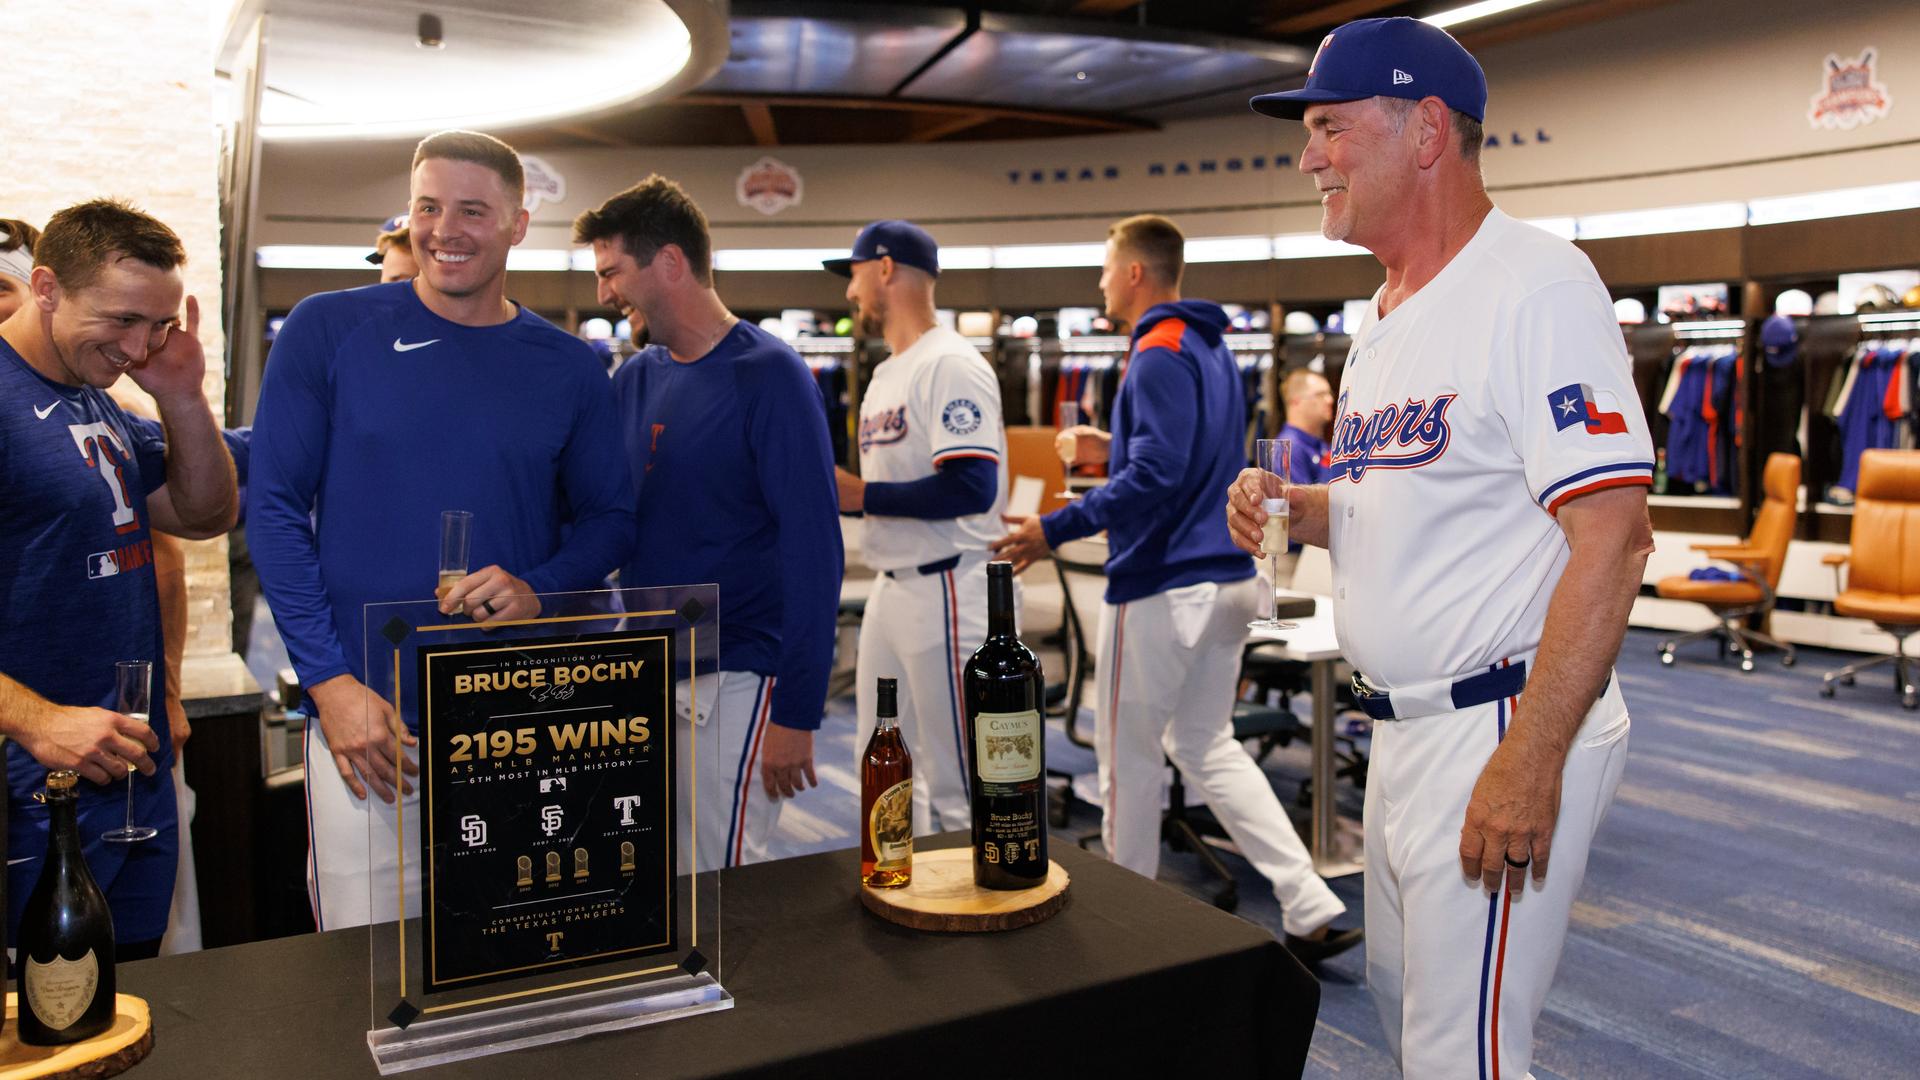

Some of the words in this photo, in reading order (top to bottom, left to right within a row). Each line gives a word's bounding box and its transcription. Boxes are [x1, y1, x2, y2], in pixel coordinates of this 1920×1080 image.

[1008, 166, 1120, 184] TEXAS
[1148, 154, 1293, 176] RANGER
[68, 421, 140, 536] T
[500, 660, 511, 668] IN
[516, 655, 585, 666] RECOGNITION
[590, 654, 602, 662] OF
[455, 668, 547, 694] BRUCE
[554, 660, 645, 686] BOCHY
[450, 727, 538, 763] 2195
[548, 716, 651, 752] WINS
[451, 764, 475, 775] AS
[494, 758, 533, 769] MLB
[552, 745, 650, 763] MANAGER
[469, 776, 493, 785] 6TH
[499, 771, 531, 781] MOST
[537, 769, 549, 777] IN
[555, 766, 578, 775] MLB
[584, 760, 633, 771] HISTORY
[614, 795, 641, 826] T
[482, 925, 506, 935] THE
[516, 918, 557, 930] TEXAS
[566, 907, 625, 922] RANGERS
[492, 906, 585, 926] CONGRATULATIONS
[591, 901, 616, 910] FROM
